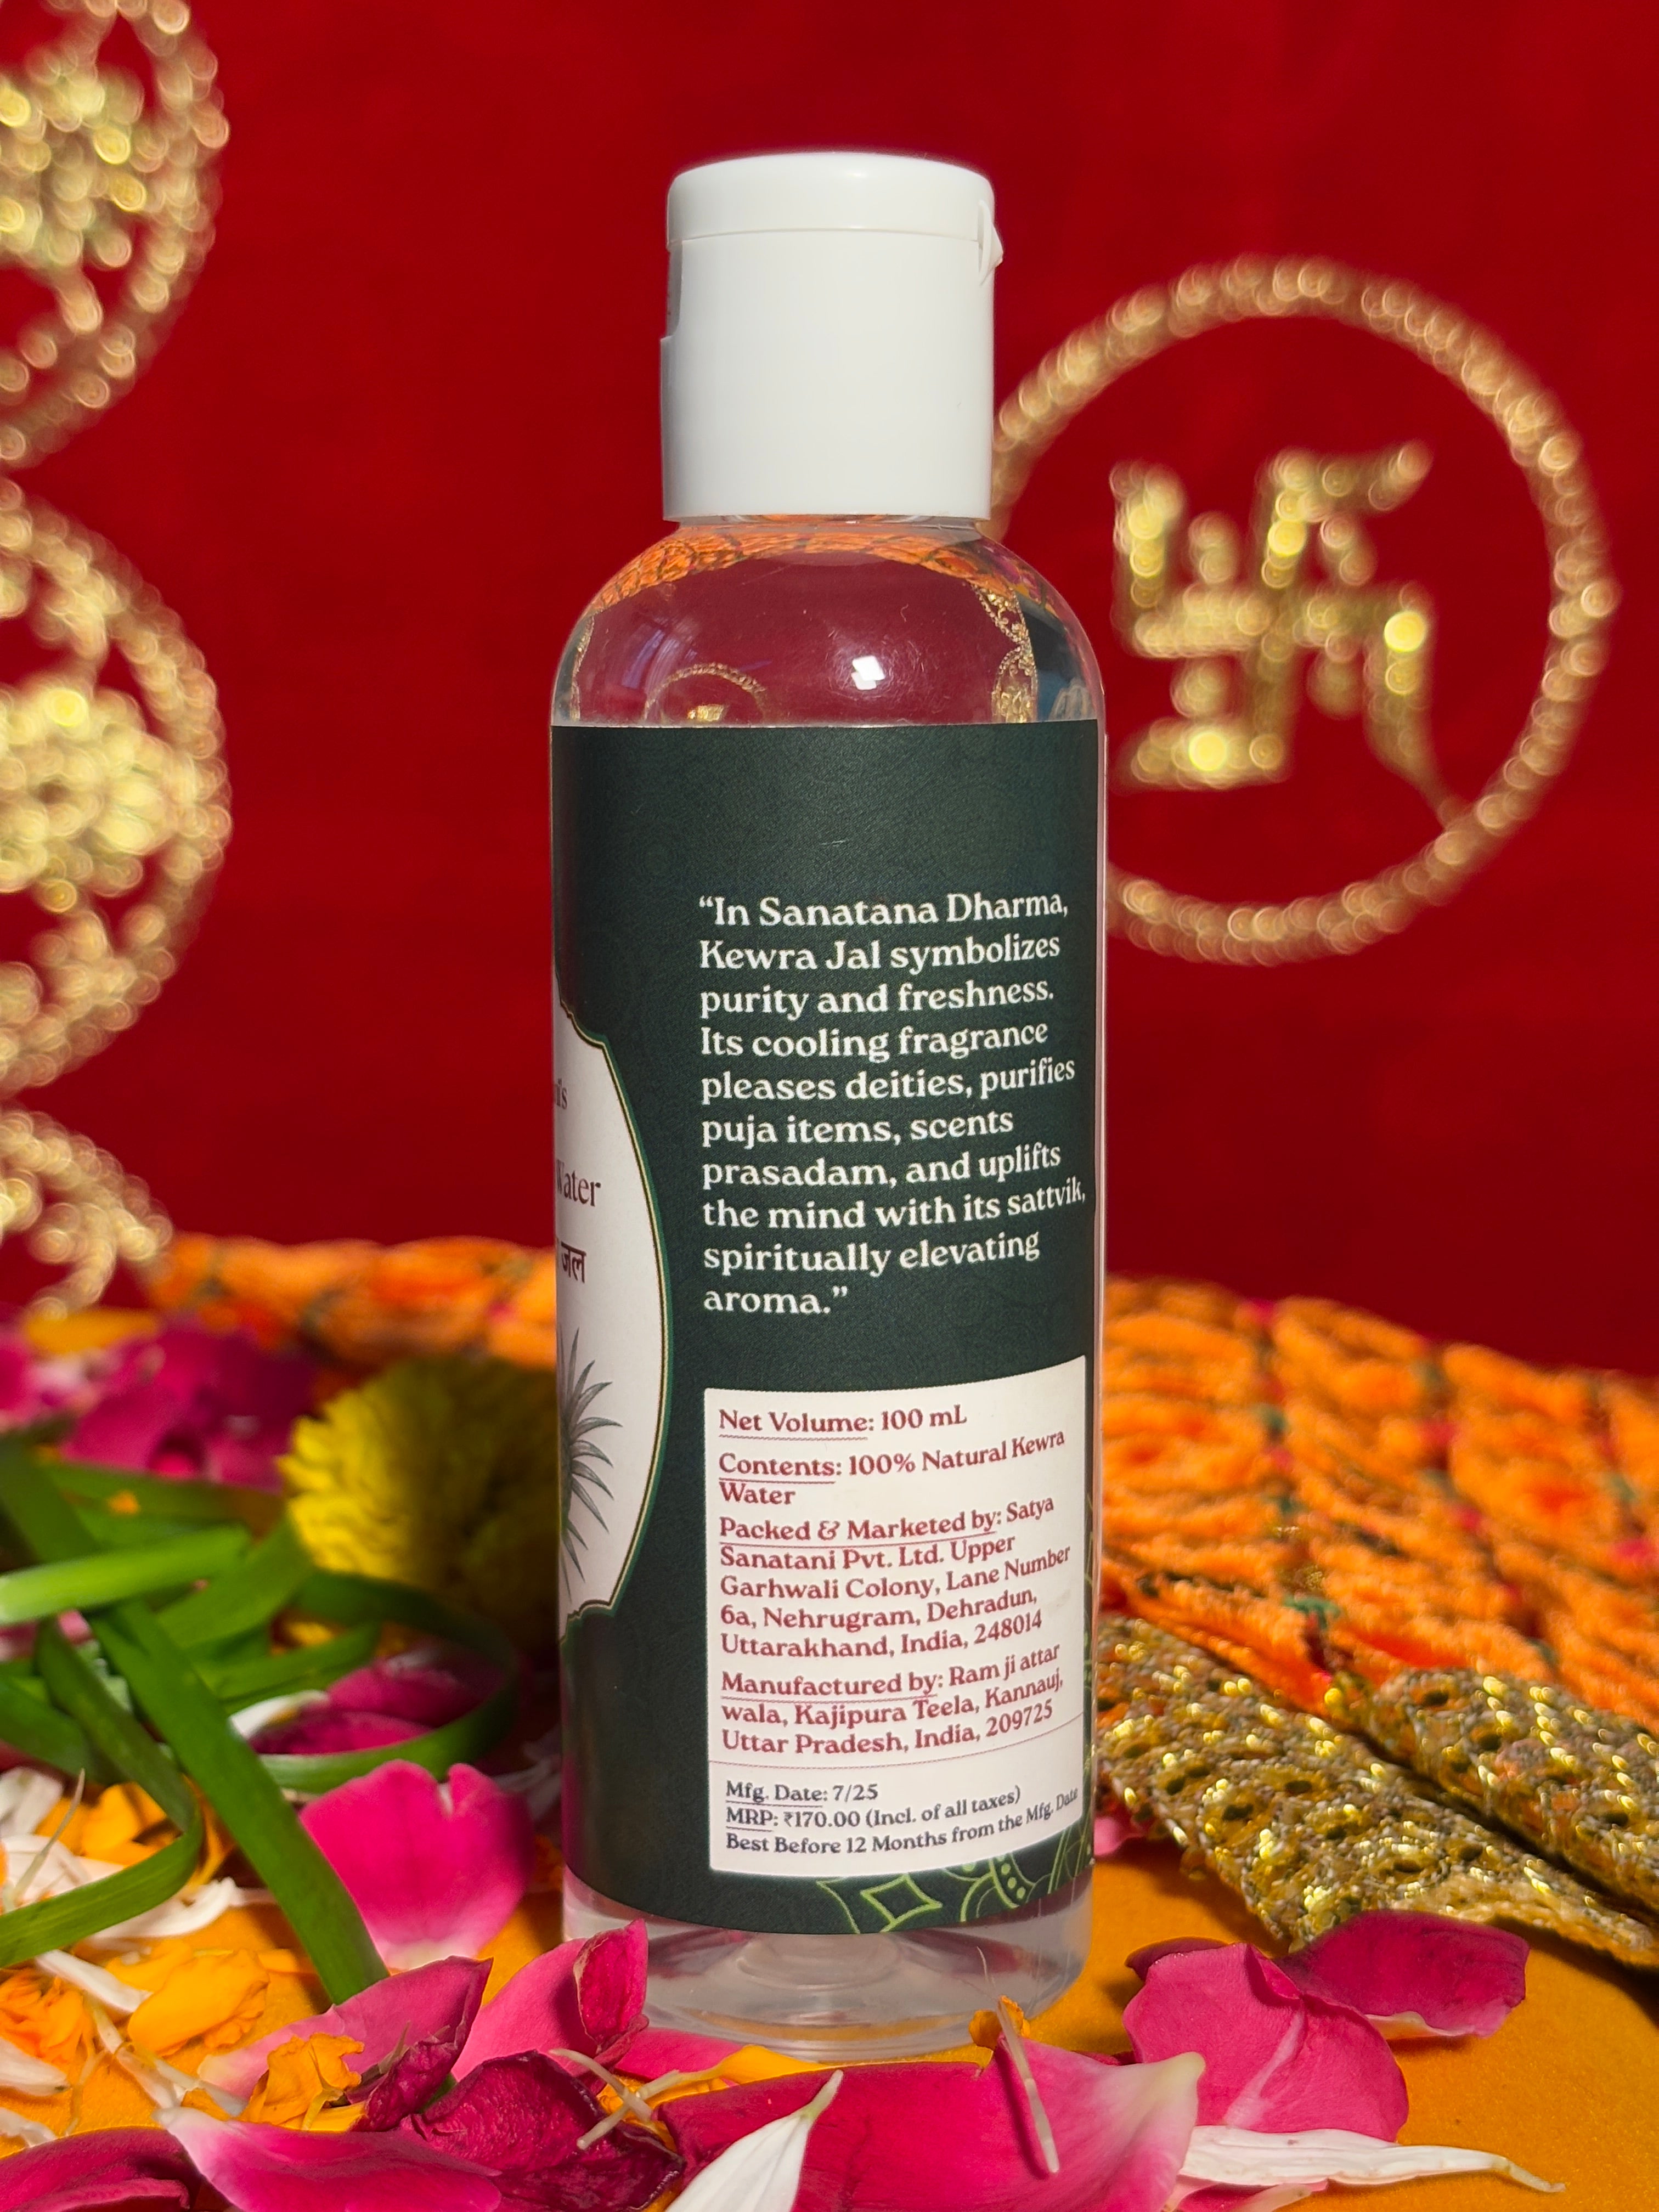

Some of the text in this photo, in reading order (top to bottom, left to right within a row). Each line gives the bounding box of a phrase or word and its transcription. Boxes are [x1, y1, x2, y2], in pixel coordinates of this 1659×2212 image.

[759, 897, 939, 927] Sanatana
[946, 892, 1068, 922] Dharma,
[699, 933, 1060, 976] Kewra Jal symbolizes
[701, 979, 1054, 1021] purity and freshness.
[701, 1023, 1048, 1064] Its cooling fragrance
[701, 1057, 1075, 1105] pleases deities, purifies
[702, 1111, 1013, 1150] puja items, scents
[703, 1142, 1061, 1190] prasadam, and uplifts
[703, 1176, 1085, 1229] the mind with its sattvik,
[560, 1240, 587, 1284] जल
[704, 1232, 1040, 1278] spiritually elevating
[704, 1285, 848, 1314] aroma.”
[719, 1404, 967, 1432] Net Volume: 100 mL
[719, 1431, 1065, 1476] Contents: 100% Natural Kewra
[719, 1481, 795, 1505] Water
[720, 1497, 1054, 1541] Packed & Marketed by: Satya
[720, 1536, 1015, 1570] Sanatani Pvt. Ltd. Upper
[720, 1546, 1070, 1599] Garhwali Colony, Lane Number
[720, 1588, 1037, 1633] 6a, Nehrugram, Dehradun,
[720, 1609, 1042, 1657] Uttarakhand, India, 248014
[722, 1671, 902, 1696] Manufactured
[909, 1672, 943, 1696] by:
[949, 1664, 1000, 1686] Ram
[1020, 1644, 1060, 1671] attar
[721, 1667, 1063, 1730] wala, Kajipura Teela, Kannauj,
[722, 1703, 1053, 1754] Uttar Pradesh, India, 209725
[726, 1780, 878, 1802] Mfg. Date: 7/25
[726, 1807, 778, 1826] MRP:
[865, 1807, 916, 1828] (Incl.
[921, 1803, 941, 1822] of
[944, 1799, 967, 1818] all
[971, 1785, 1021, 1813] taxes)
[726, 1788, 1078, 1854] Best Before 12 Months from the Mfg. Date
